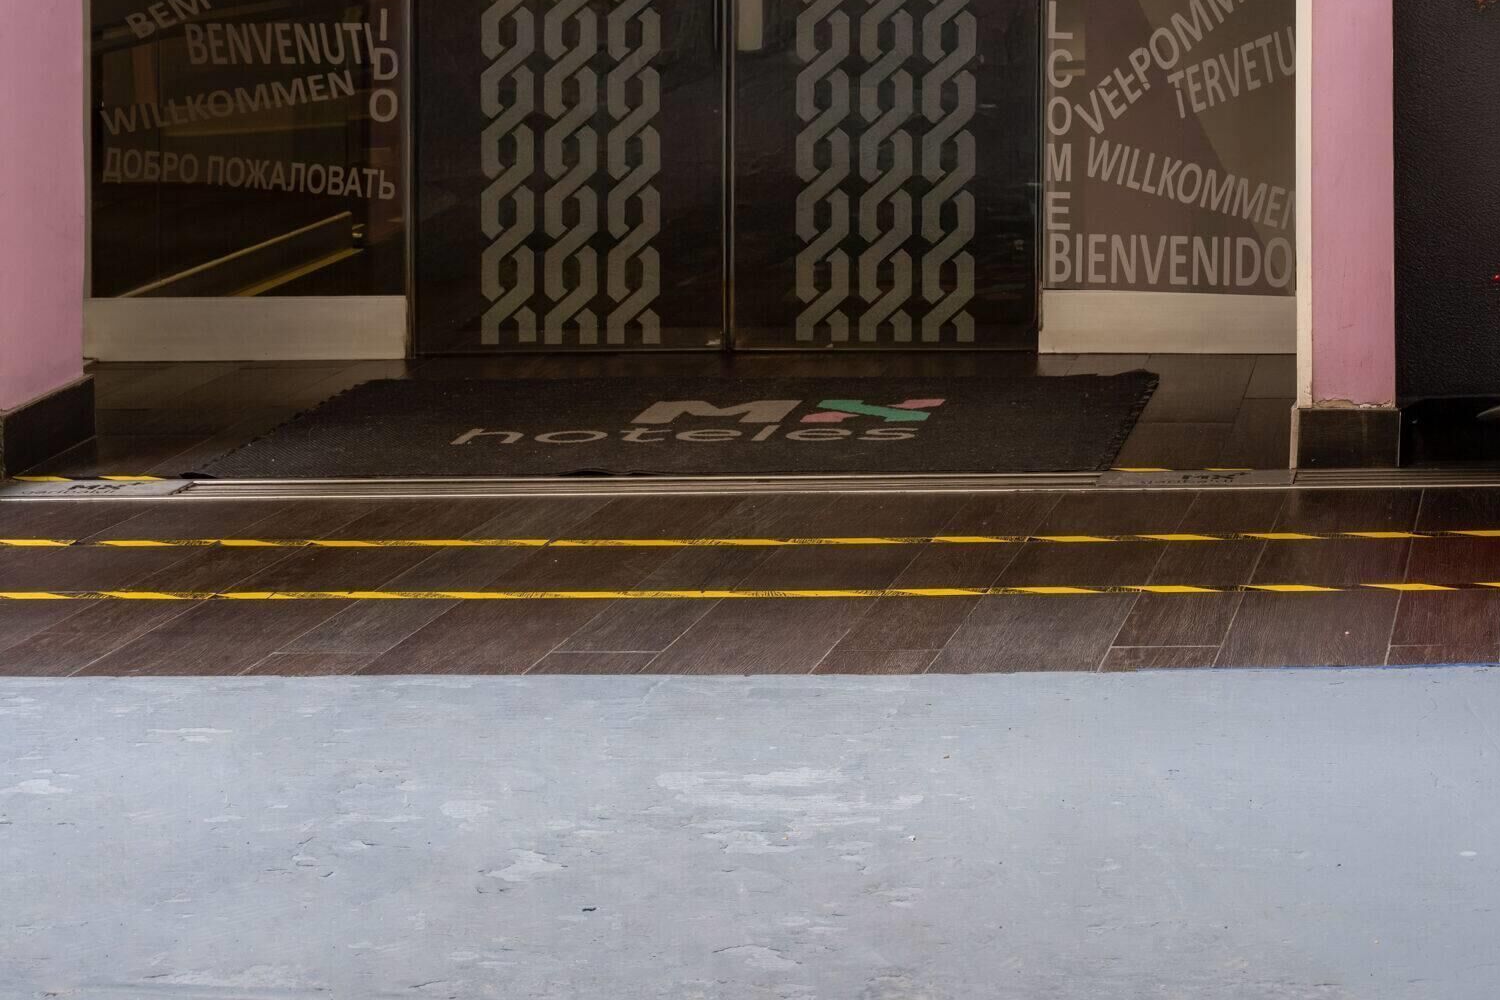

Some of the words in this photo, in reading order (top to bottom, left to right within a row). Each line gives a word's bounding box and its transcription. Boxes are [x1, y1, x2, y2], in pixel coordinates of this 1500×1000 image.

[184, 21, 375, 65] BENVENUTI
[101, 70, 357, 136] WILLKOMMEN
[102, 147, 198, 185] ДОБРО
[207, 154, 396, 201] ПОЖАЛОВАТЬ
[1050, 231, 1292, 288] BIENVENIDO
[450, 425, 919, 446] hoteles
